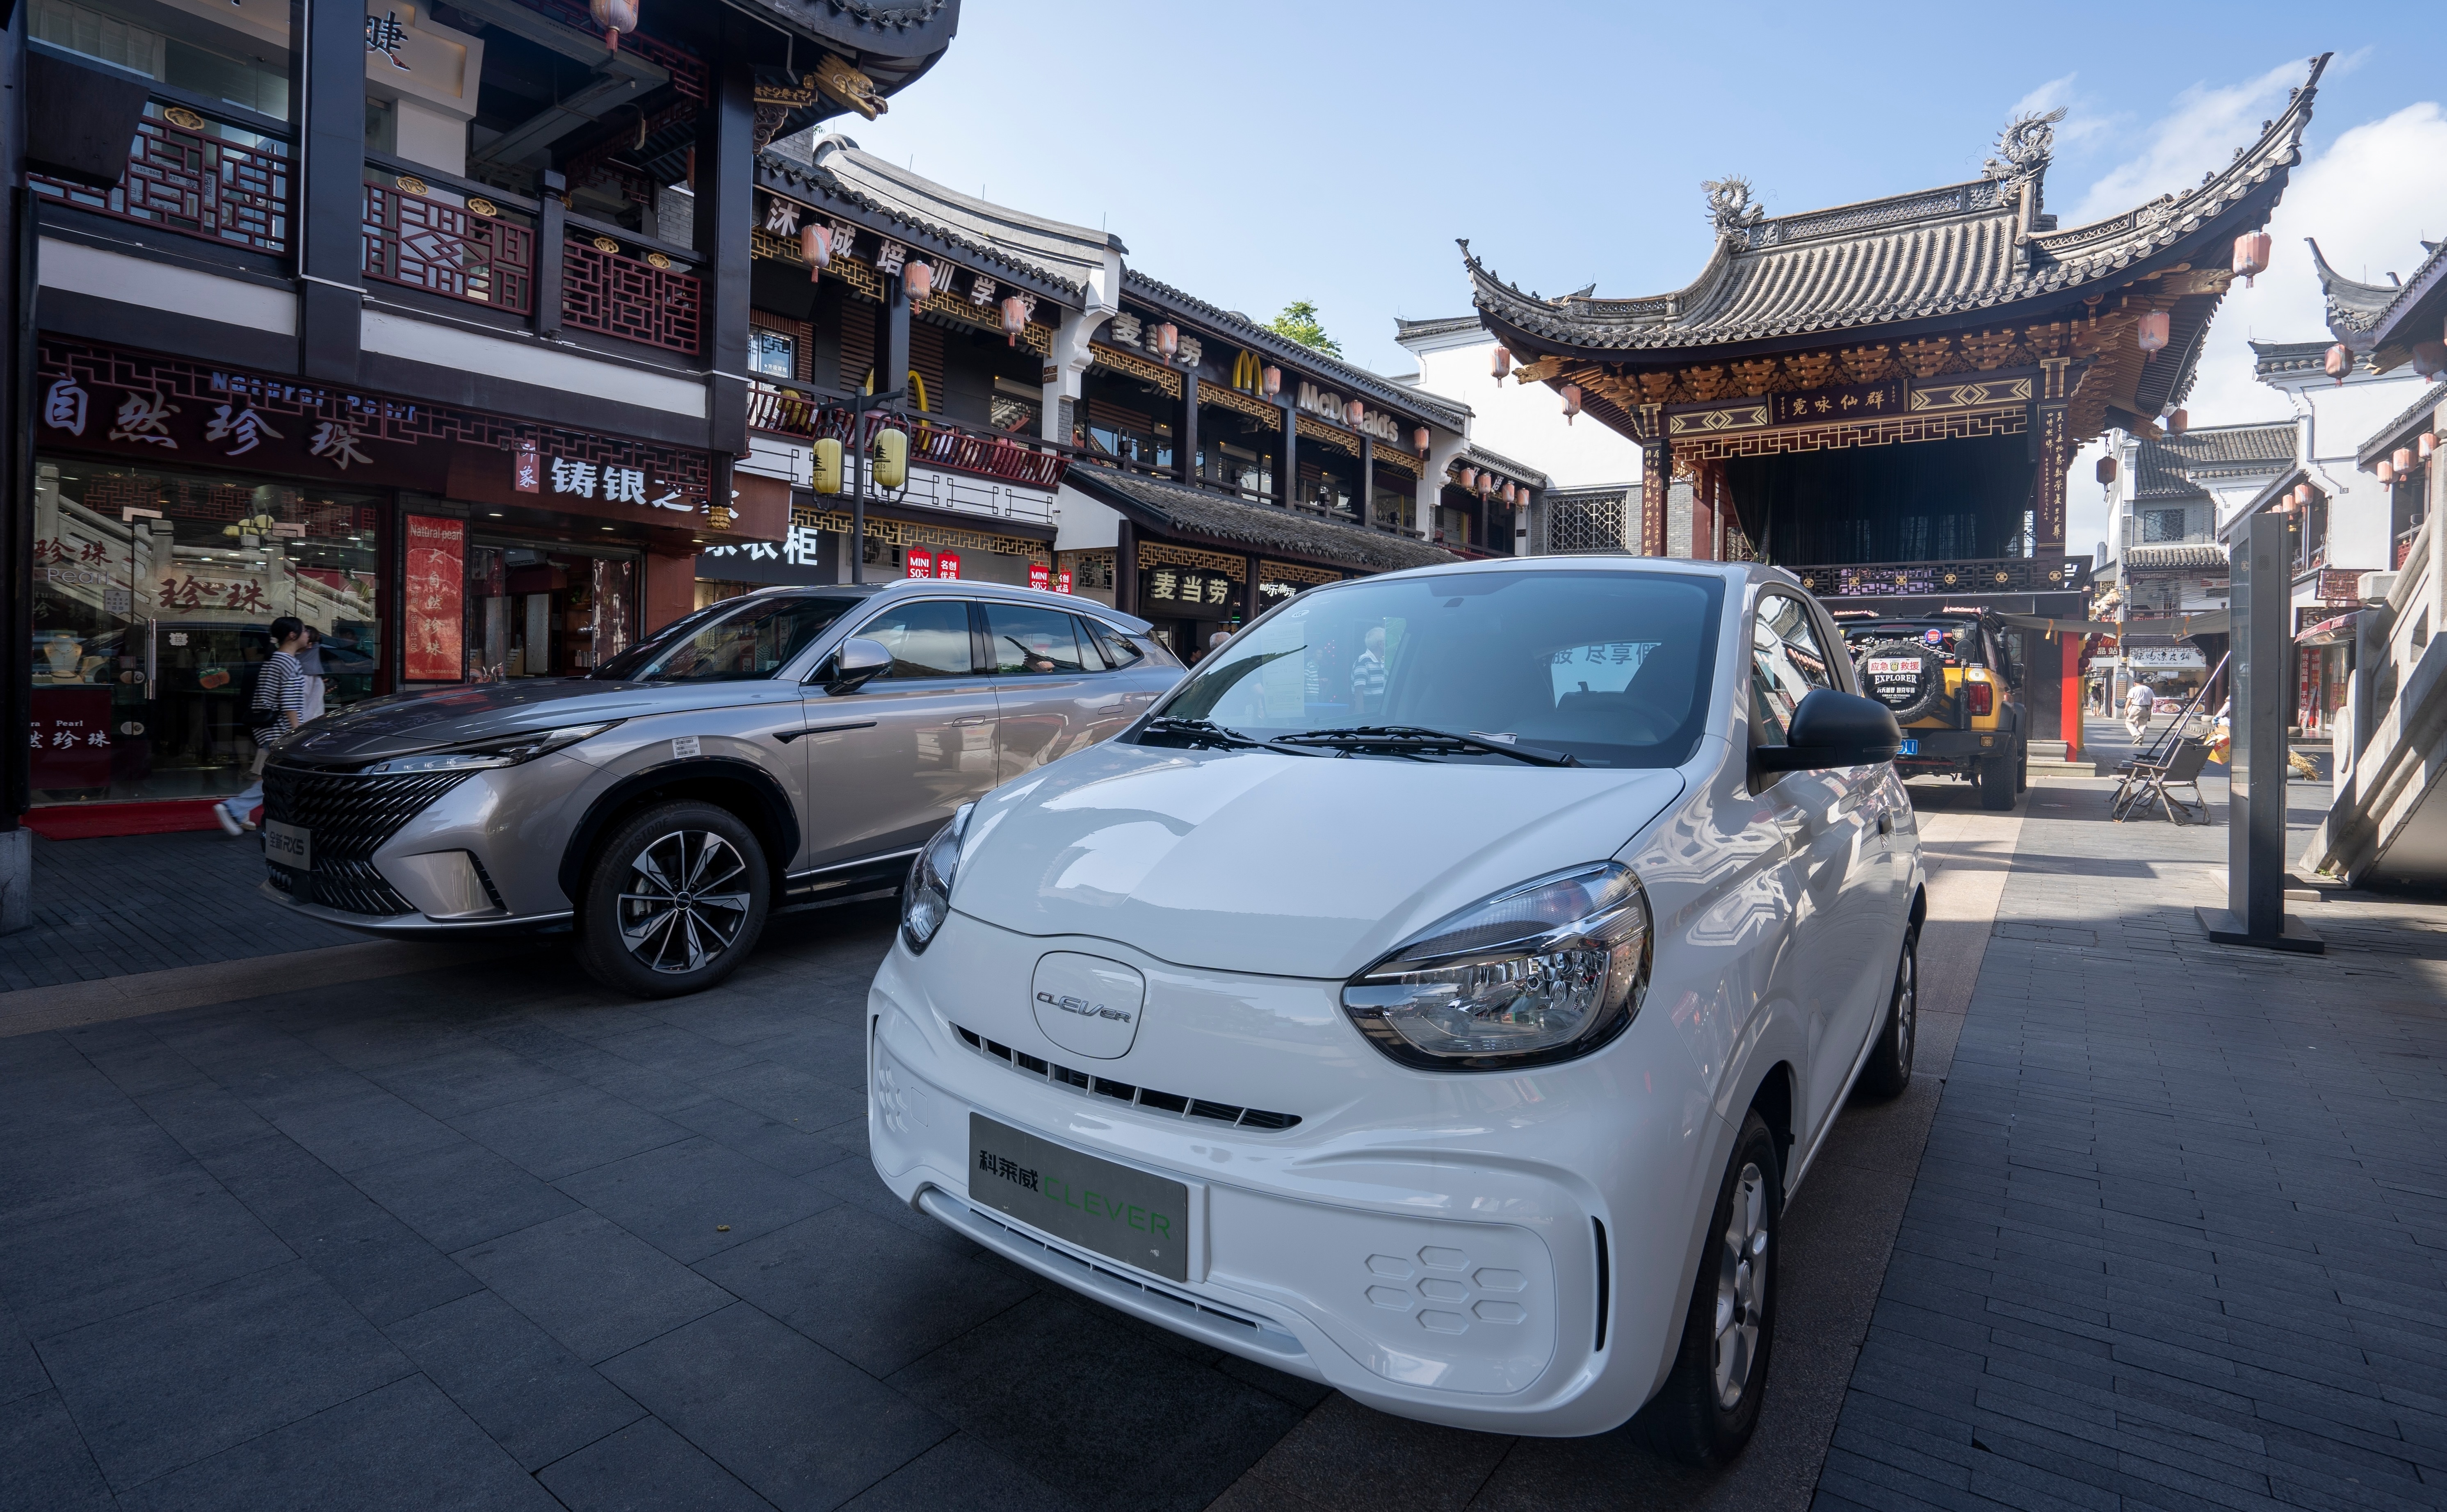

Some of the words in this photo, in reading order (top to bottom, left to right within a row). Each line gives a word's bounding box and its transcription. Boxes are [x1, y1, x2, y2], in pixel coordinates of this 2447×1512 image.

[136, 166, 179, 181] 135-8686433
[1297, 382, 1398, 442] McDald's
[44, 372, 374, 470] 自然珍珠
[410, 524, 440, 539] Natural
[442, 527, 462, 541] pearl
[910, 557, 929, 568] MINI
[940, 560, 956, 570] 名创
[47, 568, 110, 585] Pearl
[1032, 571, 1047, 580] MINI
[159, 575, 273, 615] 珍珠
[1151, 572, 1228, 604] 麦当劳
[1871, 662, 1889, 671] 应急
[1901, 661, 1919, 670] 救援
[1875, 675, 1917, 684] EXPLORER
[1036, 991, 1132, 1024] CLEVER
[979, 1149, 1039, 1193] 科莱威
[1043, 1175, 1171, 1240] CLEVER
